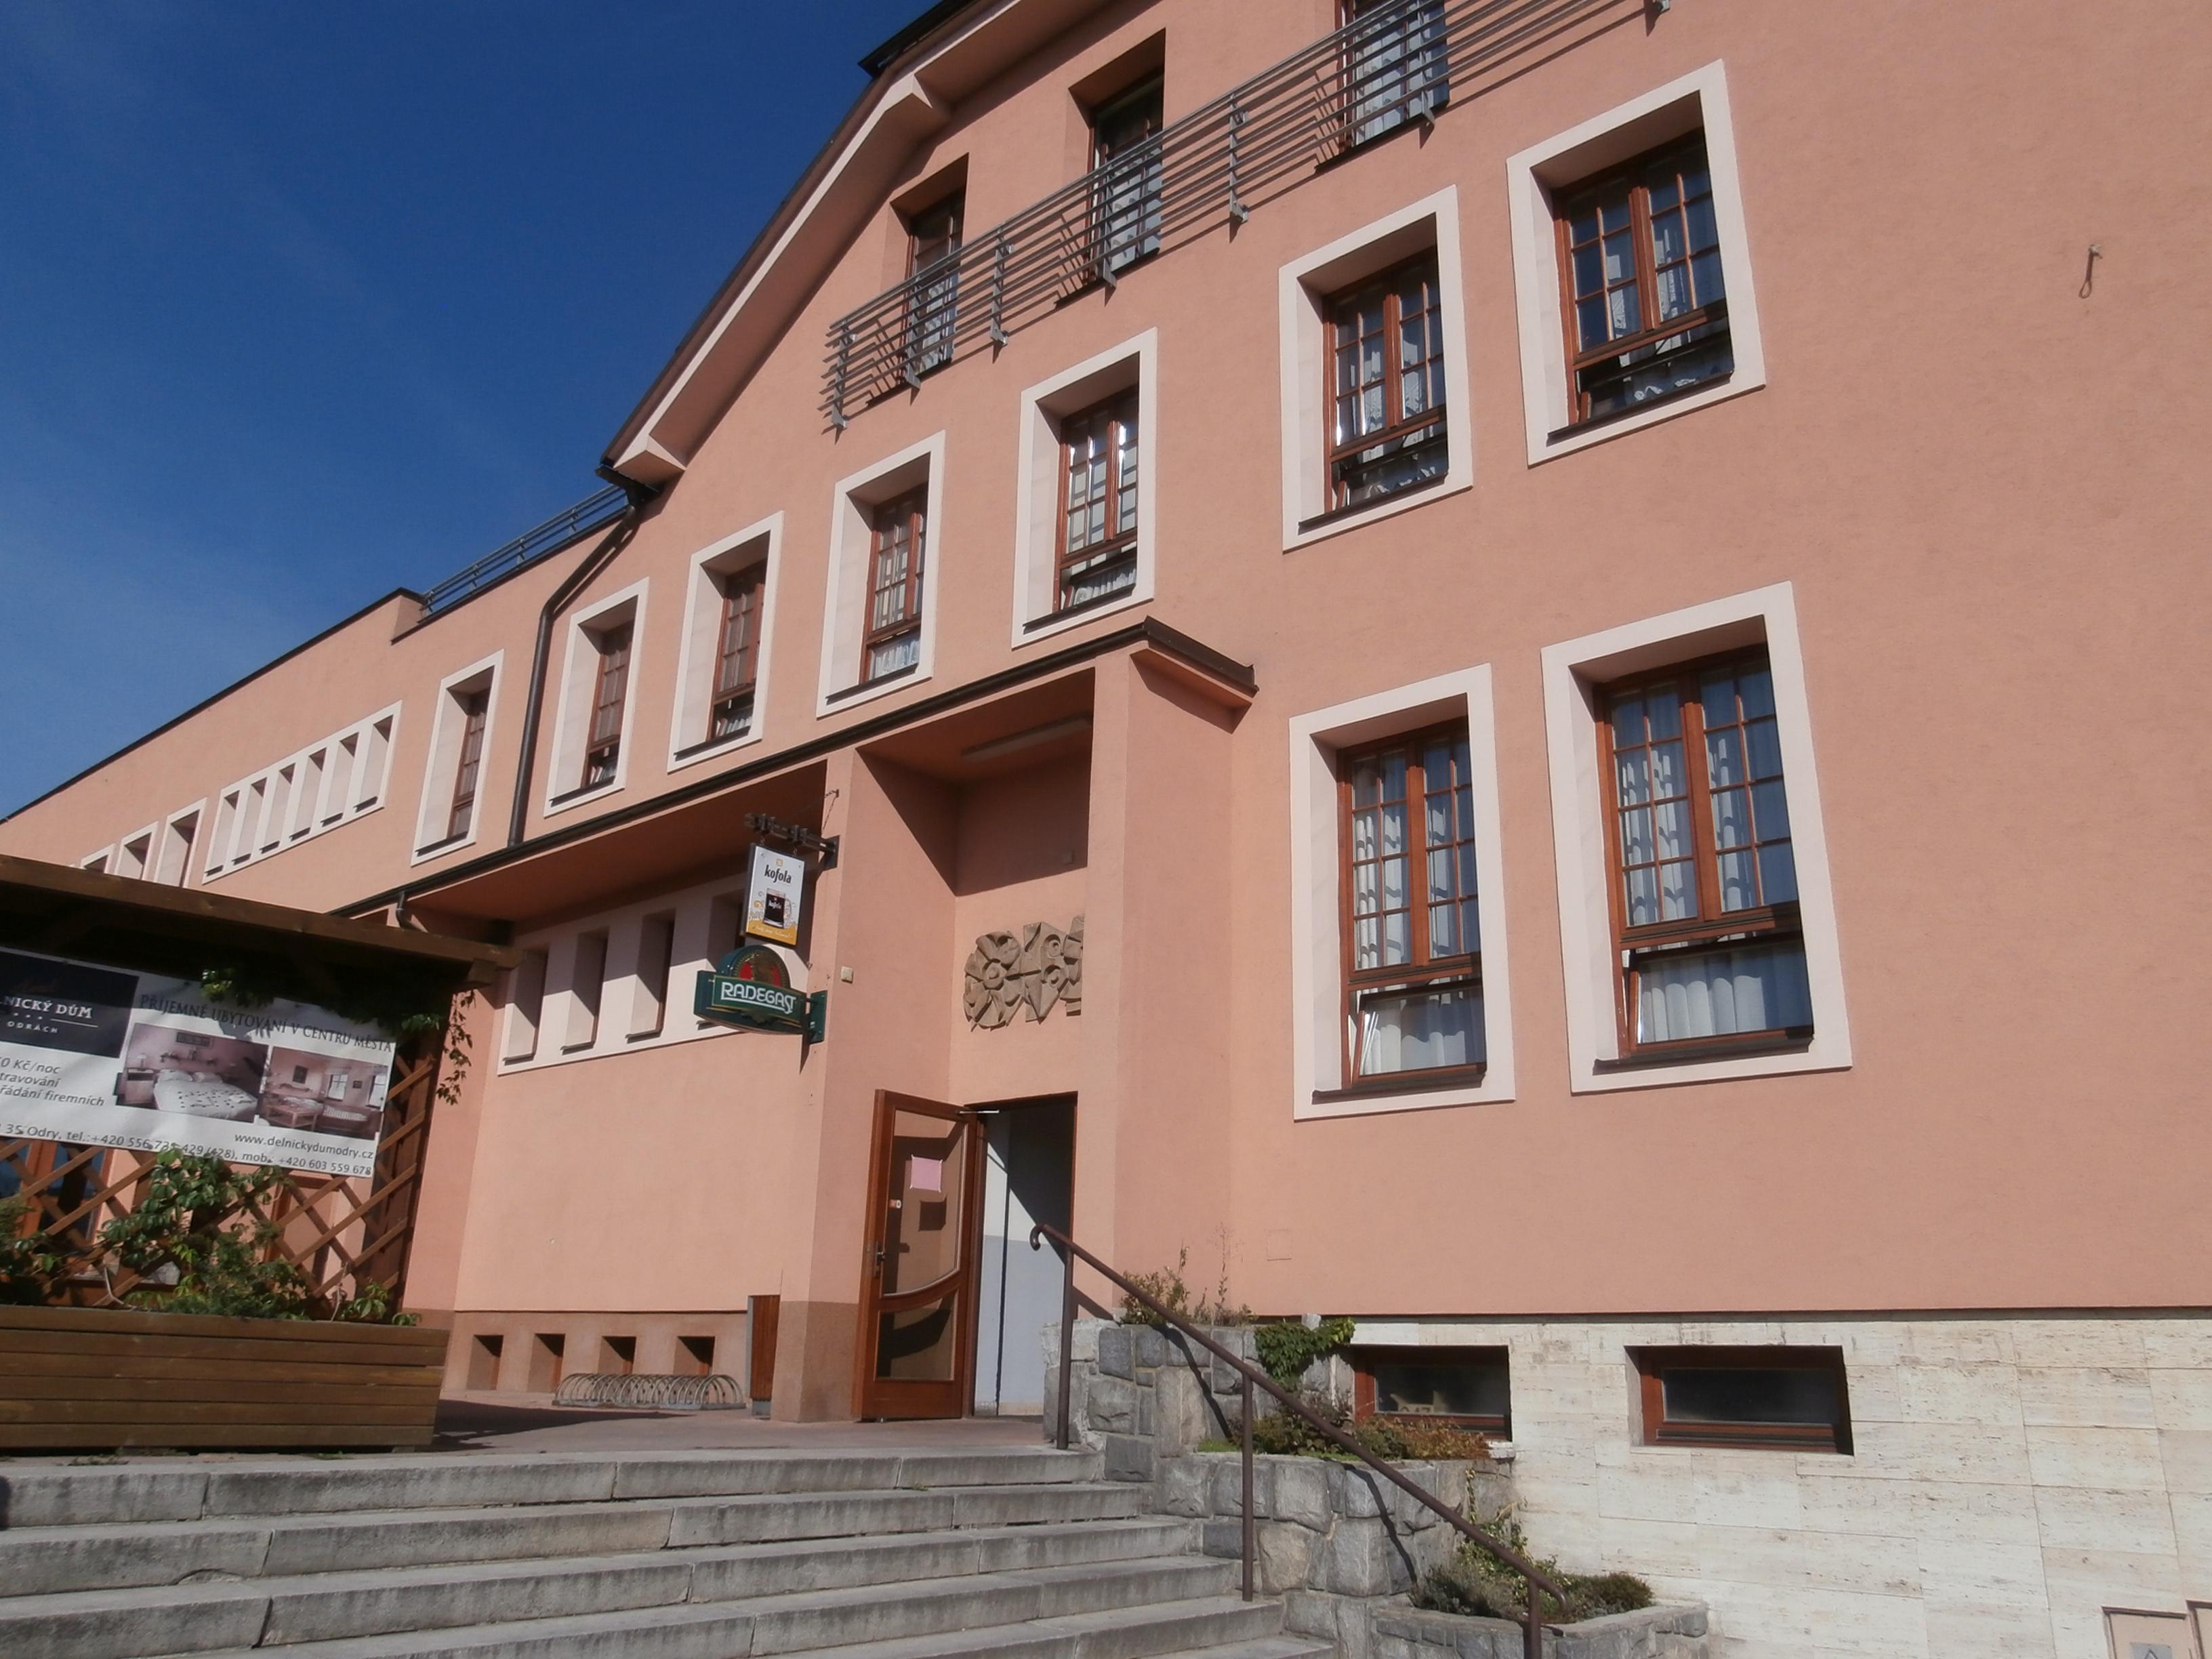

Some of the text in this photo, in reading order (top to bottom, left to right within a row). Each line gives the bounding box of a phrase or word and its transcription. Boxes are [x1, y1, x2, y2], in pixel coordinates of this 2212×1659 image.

[764, 864, 792, 884] kofola
[0, 996, 53, 1012] NICKÝ
[721, 982, 796, 1015] RADEGAST
[140, 994, 208, 1019] PŘÍJEMNÉ
[212, 1008, 288, 1033] UBYTOVÁNÍ
[291, 1023, 300, 1034] V
[303, 1025, 352, 1045] CENTRU
[14, 1059, 61, 1074] Kč/noc
[44, 1090, 105, 1106] firemních
[128, 1138, 149, 1149] 556
[183, 1143, 203, 1155] 429
[279, 1157, 306, 1168] +420
[308, 1160, 327, 1170] 603
[331, 1162, 350, 1173] 559
[352, 1165, 371, 1176] 678
[234, 1134, 373, 1160] www.delnickydumodry.cz
